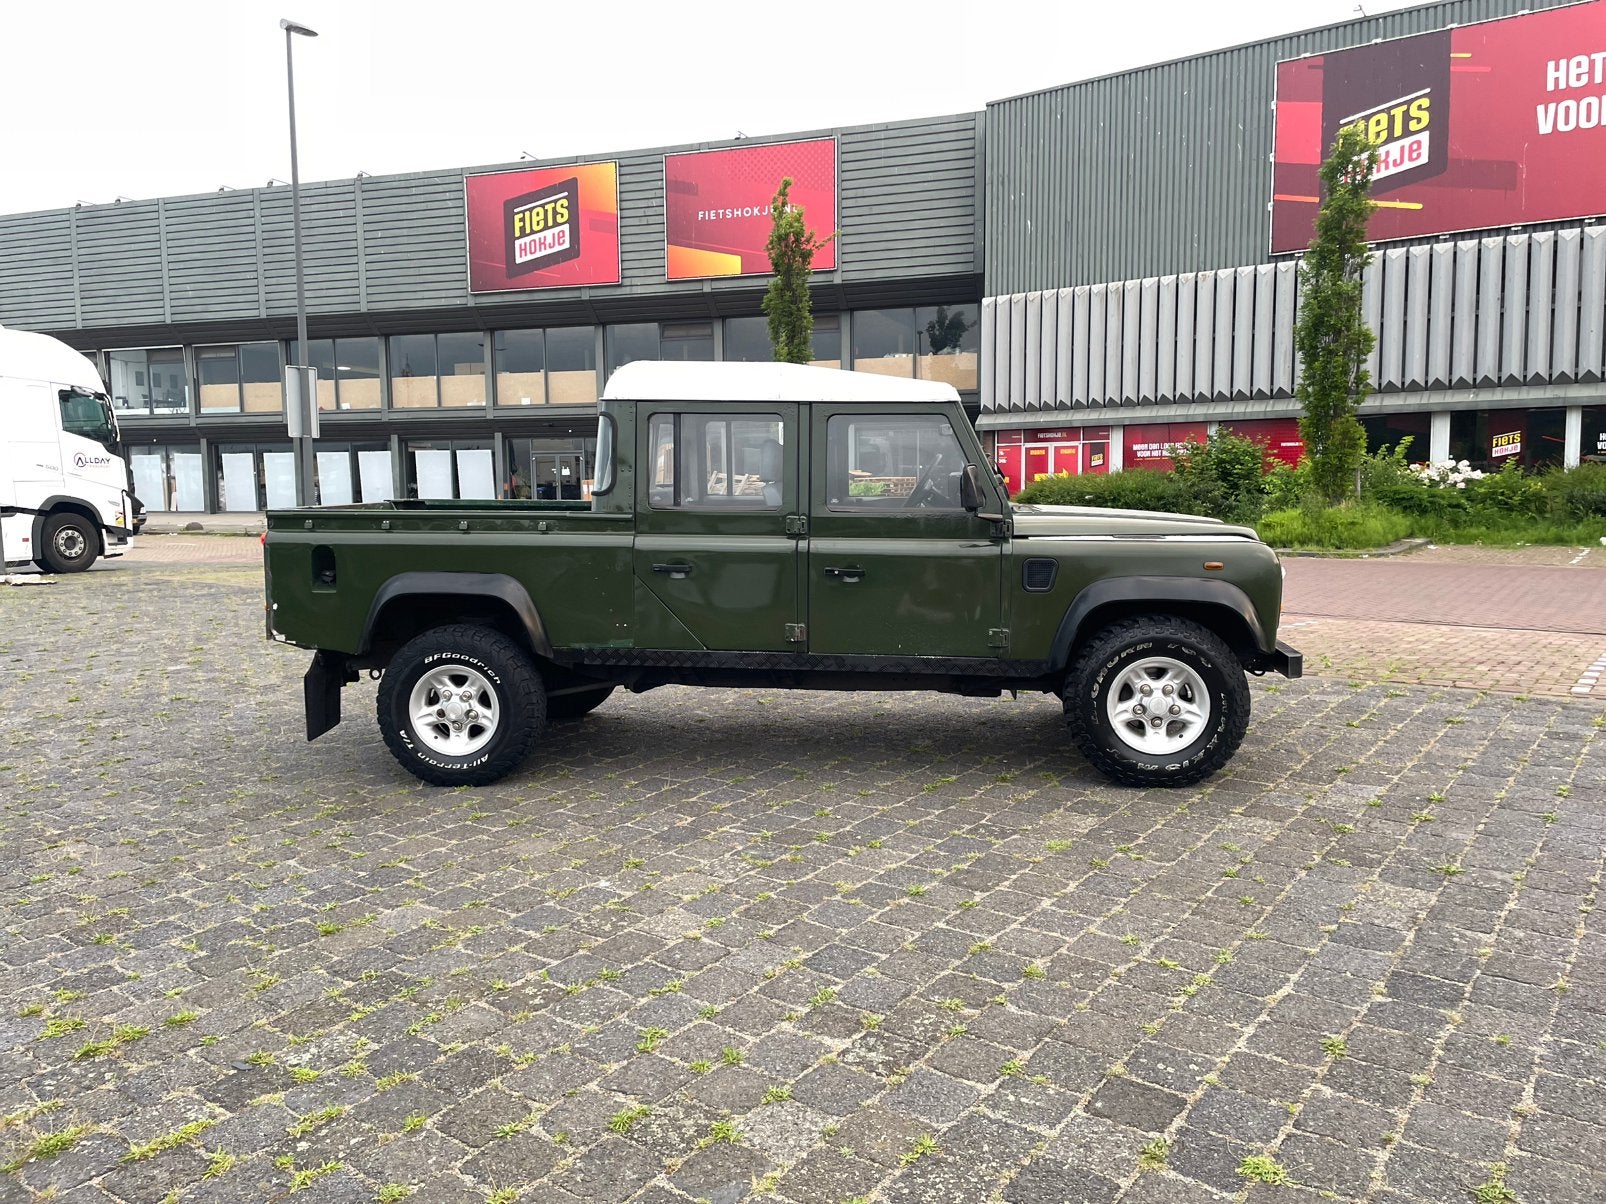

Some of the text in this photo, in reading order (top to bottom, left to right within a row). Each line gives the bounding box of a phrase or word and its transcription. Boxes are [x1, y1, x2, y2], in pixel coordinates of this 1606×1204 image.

[1339, 97, 1430, 152] eTS
[1536, 94, 1606, 135] VOO
[1342, 139, 1422, 184] KJe
[514, 198, 569, 238] FIeTS
[519, 229, 566, 258] HOKJe
[1492, 433, 1521, 448] FIeTS
[75, 454, 111, 467] ALLDAY
[424, 652, 501, 684] BFGoodrich
